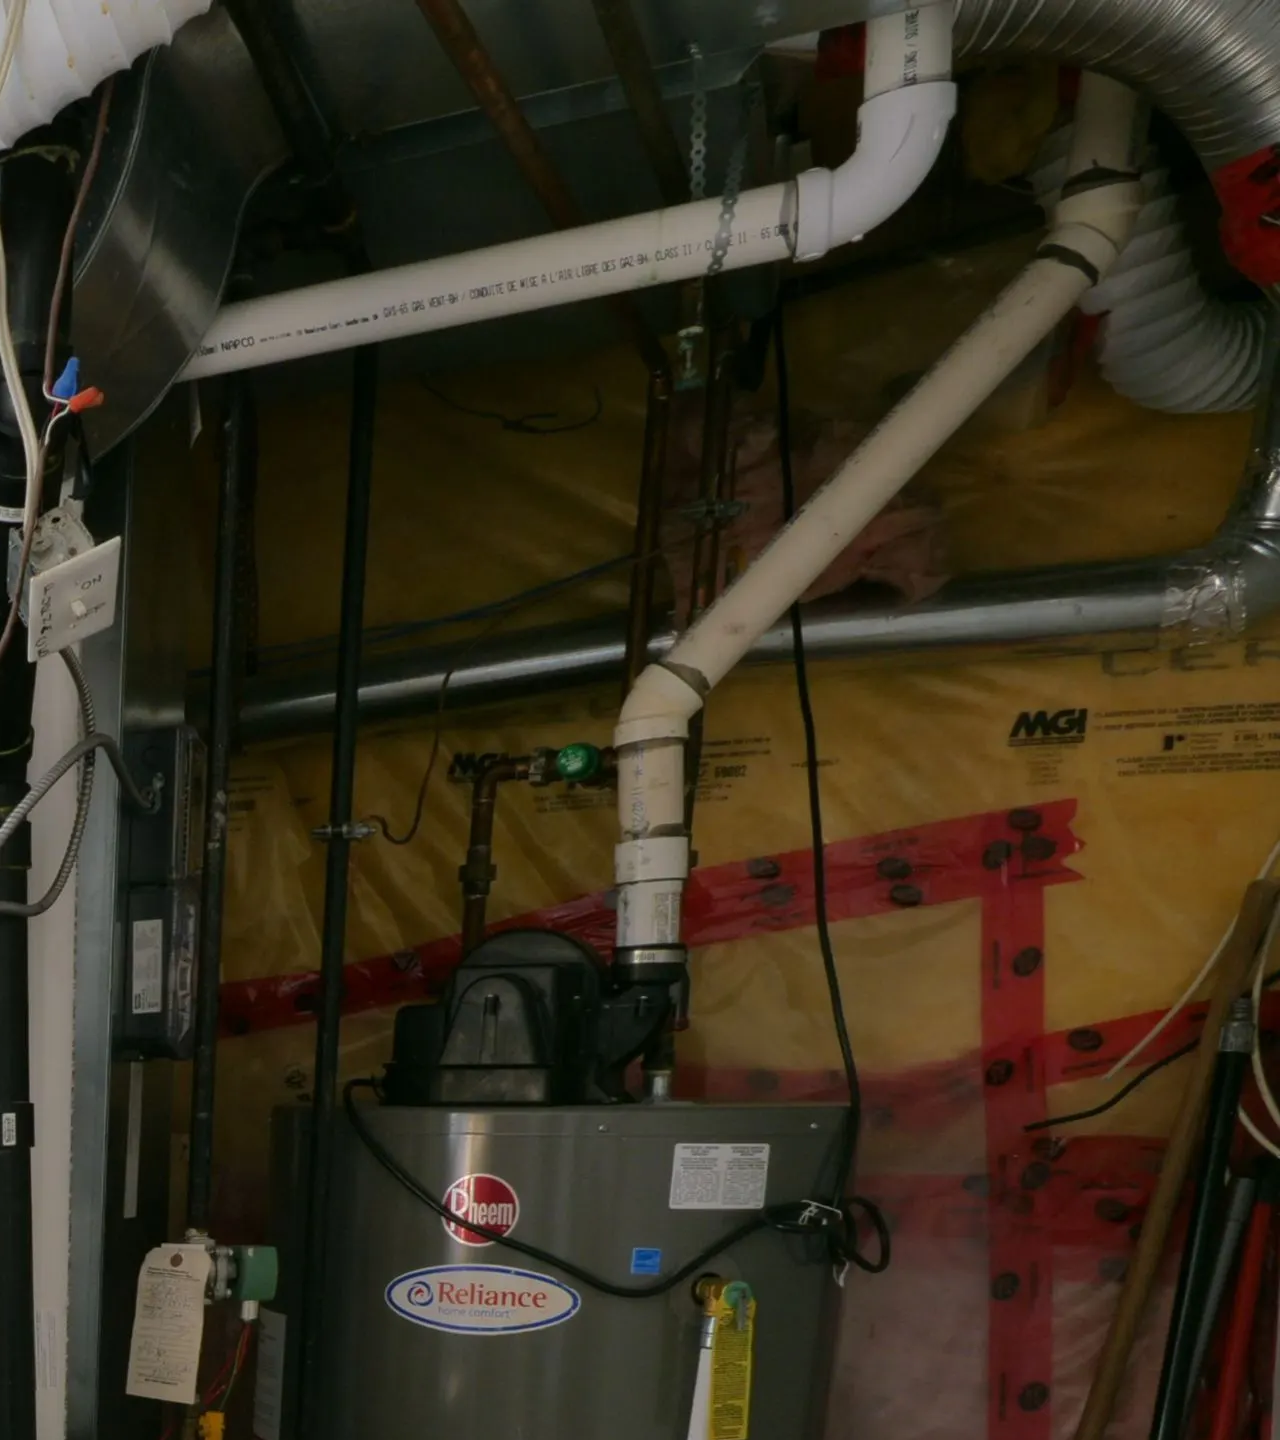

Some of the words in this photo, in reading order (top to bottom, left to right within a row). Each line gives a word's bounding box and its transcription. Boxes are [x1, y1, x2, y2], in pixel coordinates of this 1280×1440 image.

[469, 281, 505, 301] CONDUITE
[507, 280, 518, 293] DE
[520, 275, 539, 291] MISE
[550, 268, 574, 284] L'AIR
[575, 263, 599, 280] LIBRE
[602, 259, 617, 274] DES
[655, 247, 680, 262] CLASS
[220, 335, 255, 352] NAPCO
[81, 574, 103, 590] ON
[1008, 708, 1088, 737] MGI
[451, 1184, 514, 1231] Rheem
[438, 1281, 548, 1308] Reliance
[438, 1306, 466, 1317] home
